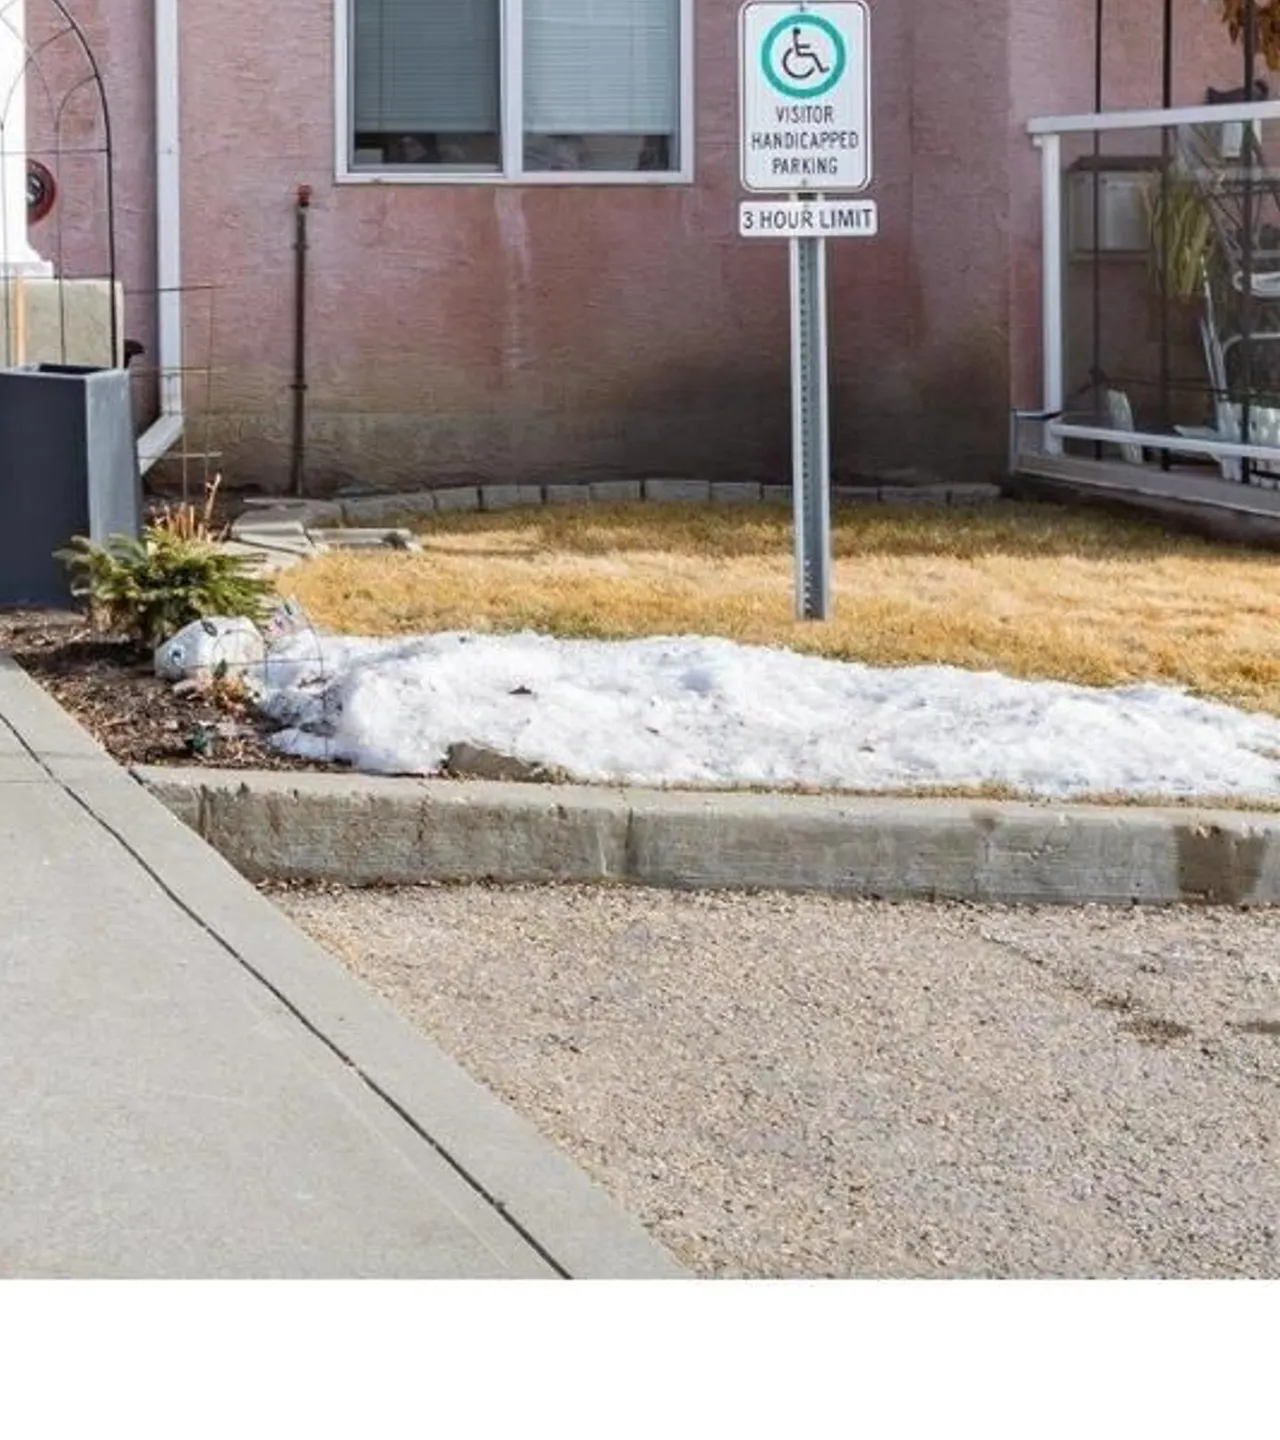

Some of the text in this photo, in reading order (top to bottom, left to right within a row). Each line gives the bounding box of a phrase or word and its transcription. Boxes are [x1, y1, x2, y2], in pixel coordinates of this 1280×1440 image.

[775, 105, 834, 123] VISITOR
[751, 132, 859, 150] HANDICAPPED
[771, 157, 838, 175] PARKING
[743, 209, 873, 230] 3 HOUR LIMIT
